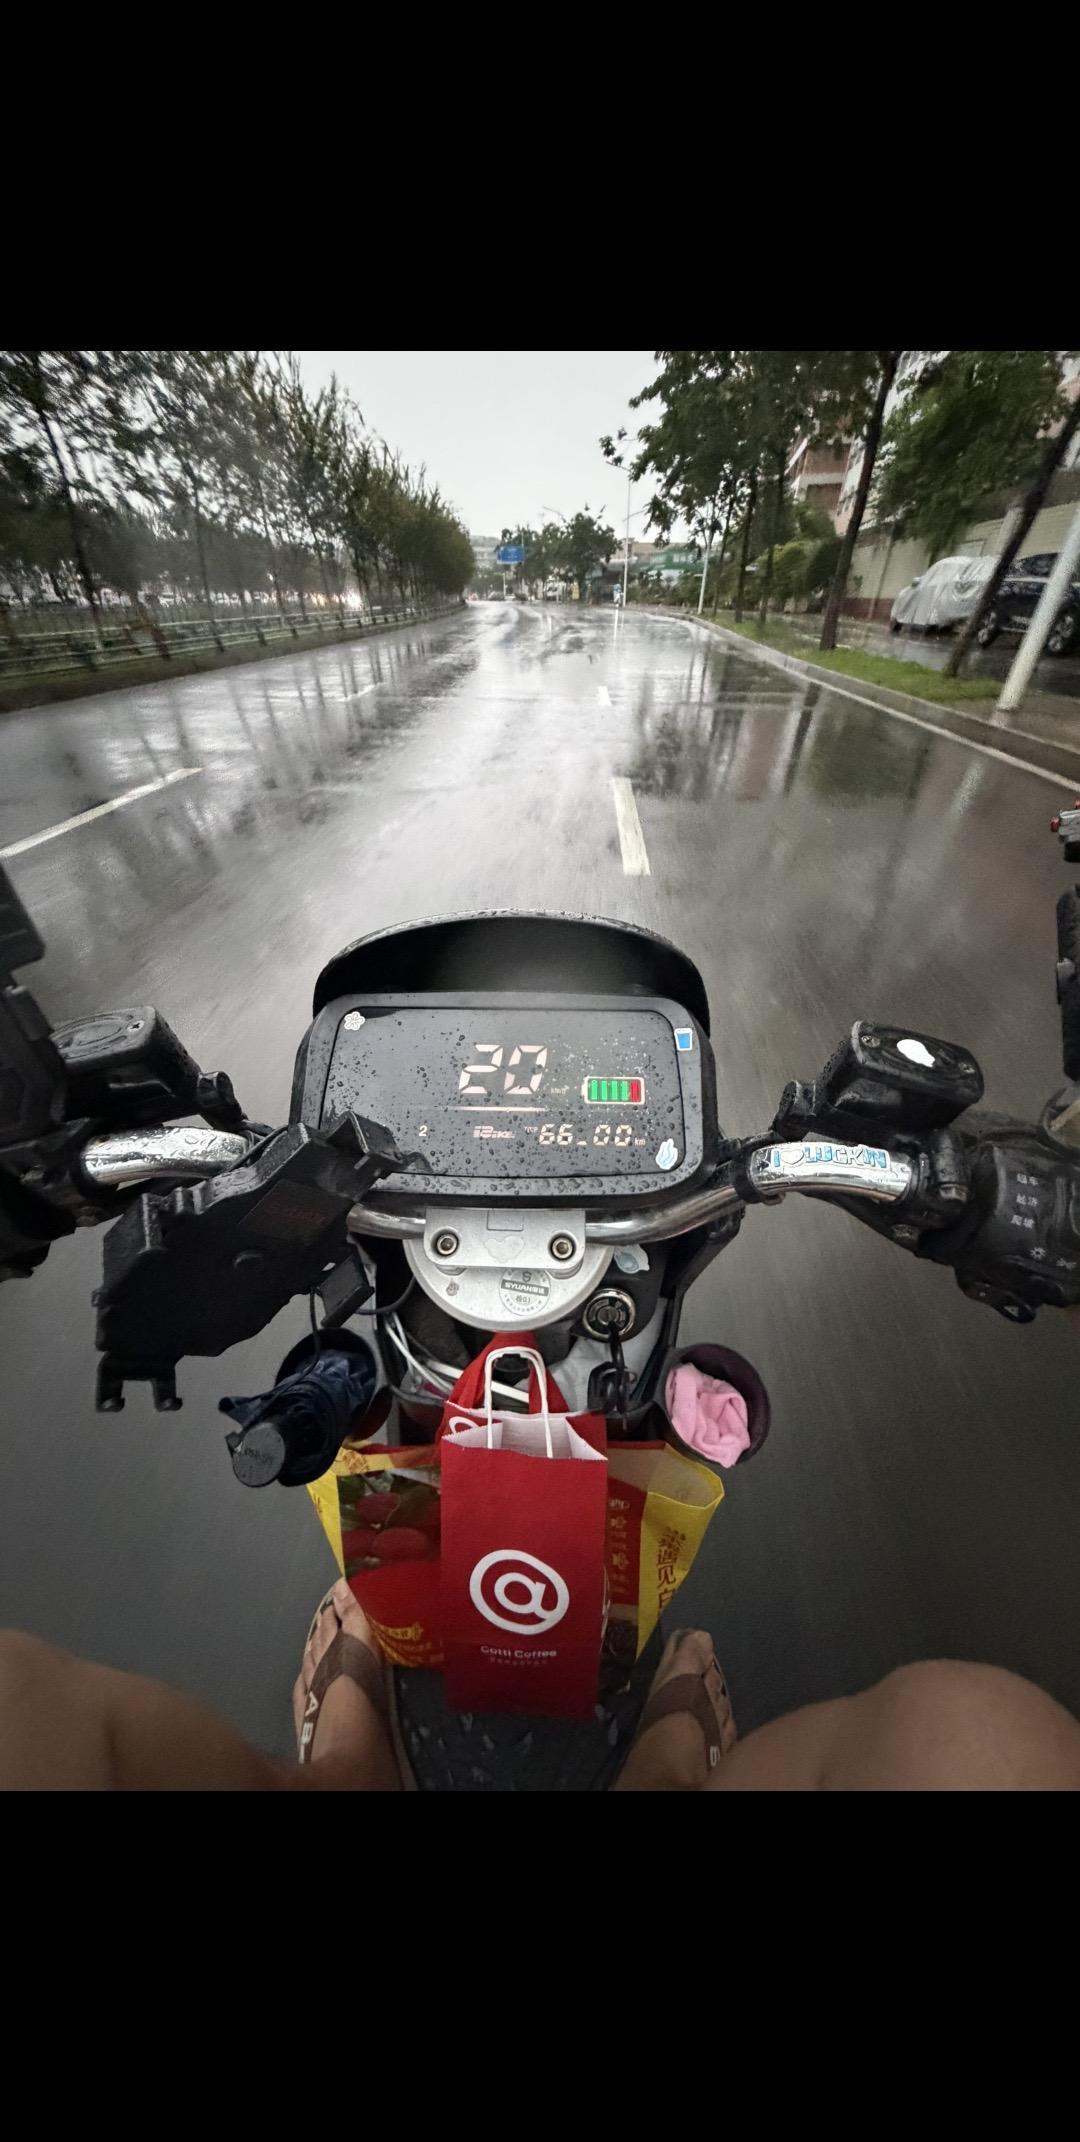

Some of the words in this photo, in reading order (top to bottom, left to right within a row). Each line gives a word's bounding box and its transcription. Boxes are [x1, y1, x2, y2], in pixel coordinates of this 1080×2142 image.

[458, 1044, 547, 1095] 20
[418, 1124, 428, 1138] 2
[804, 1145, 888, 1169] LUCKIN
[513, 1649, 558, 1659] Coffee
